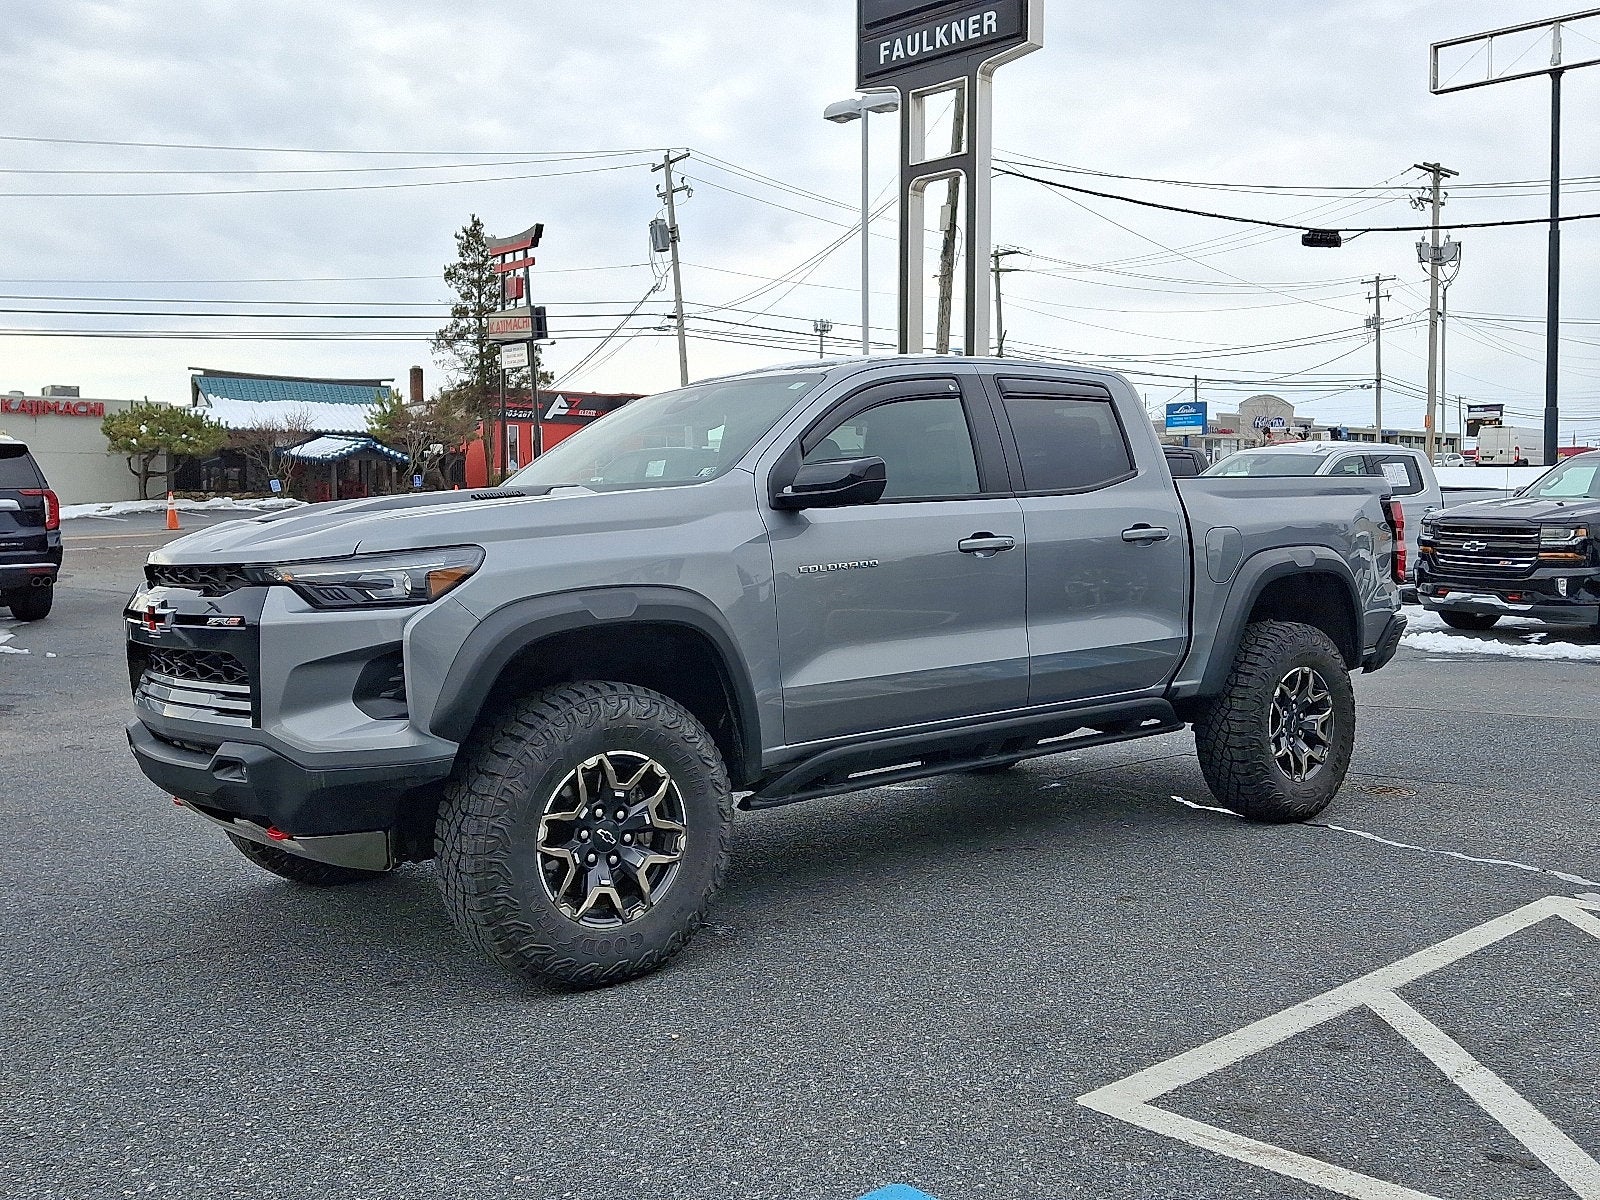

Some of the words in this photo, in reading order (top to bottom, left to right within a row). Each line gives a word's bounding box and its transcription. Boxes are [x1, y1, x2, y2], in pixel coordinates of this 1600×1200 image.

[879, 10, 998, 65] FAULKNER
[489, 317, 531, 334] KAJIMACHI
[0, 398, 105, 416] KAJIMACHI
[1172, 404, 1197, 414] Linde
[798, 559, 880, 574] COLORADO
[206, 617, 241, 626] ZR2
